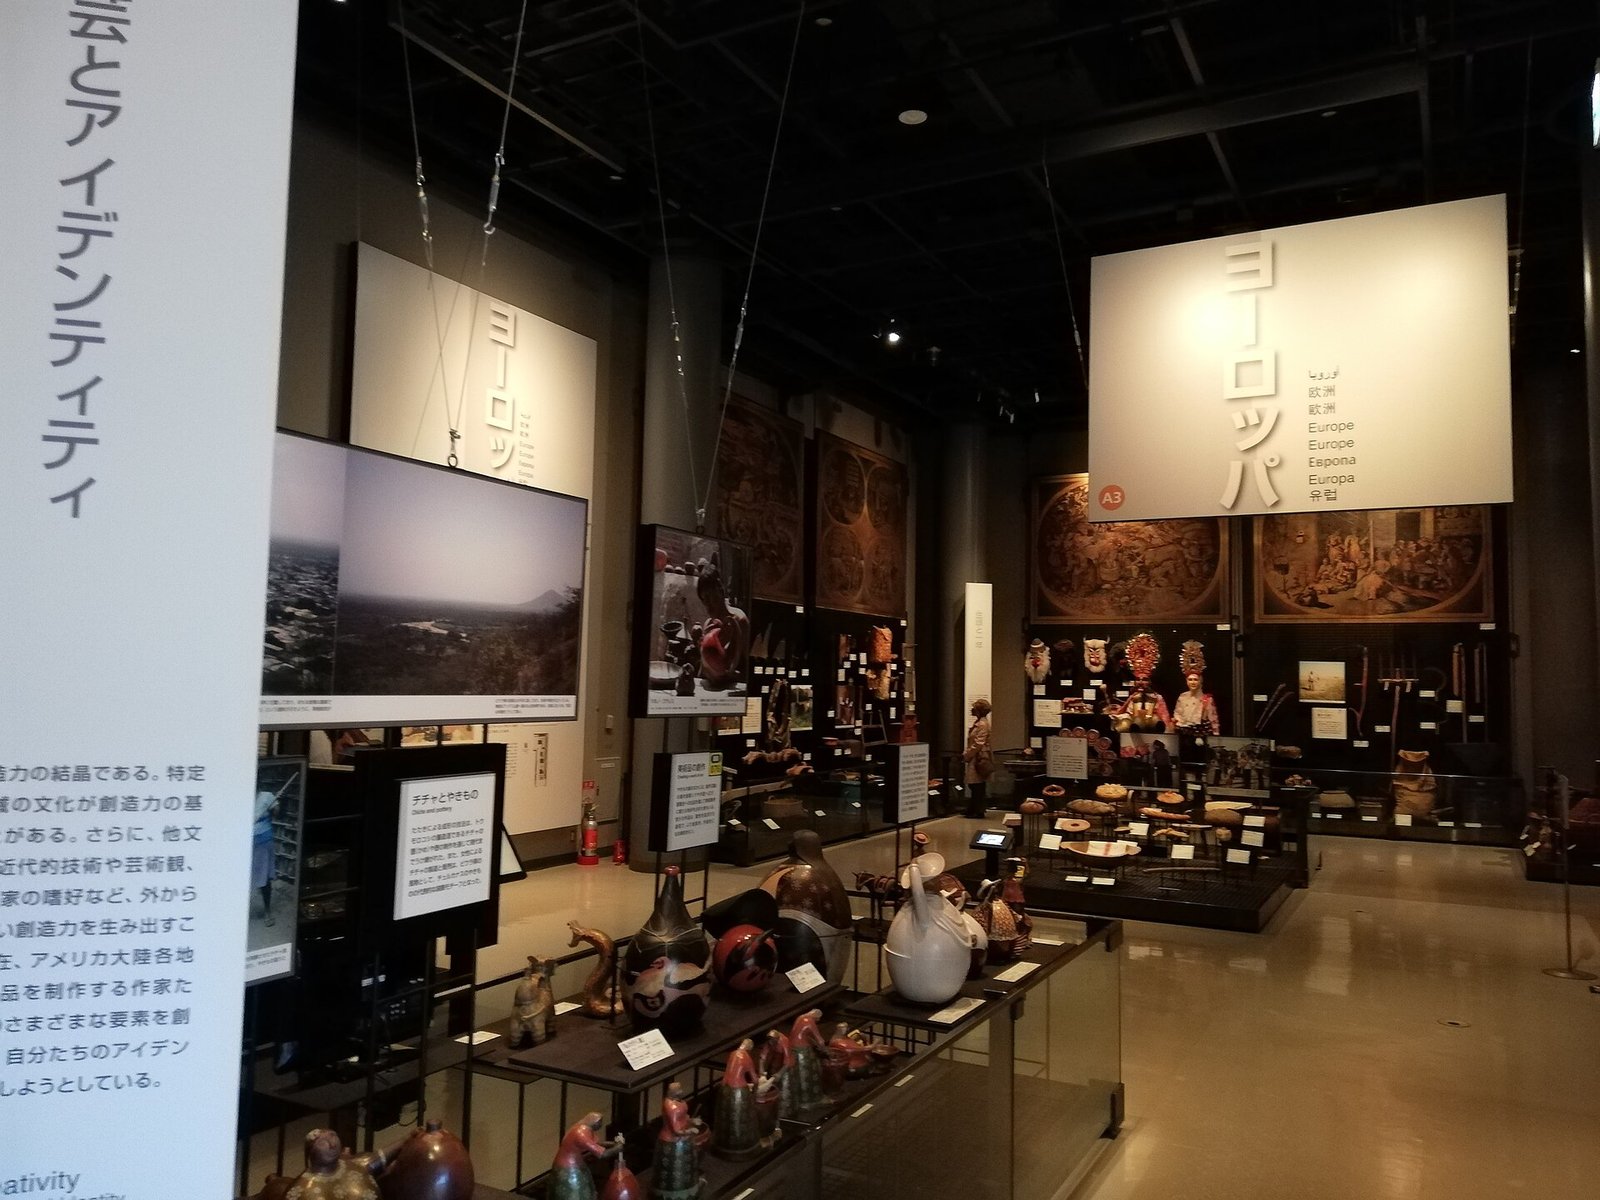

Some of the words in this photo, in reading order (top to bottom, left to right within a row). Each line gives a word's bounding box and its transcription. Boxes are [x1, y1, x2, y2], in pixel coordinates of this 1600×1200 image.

[1219, 240, 1281, 509] ヨーロッパ
[1308, 421, 1355, 433] Europe
[1308, 439, 1355, 450] Europe
[1308, 456, 1357, 468] Европа
[1308, 474, 1356, 485] Europa
[1101, 491, 1122, 504] A3
[1309, 488, 1338, 501] 유럽
[412, 789, 479, 806] チチャとやきもの
[0, 825, 202, 844] がある。さらに、他文
[0, 1008, 191, 1032] さまざまな要素を創
[6, 1039, 190, 1065] 自分たちのアイデン
